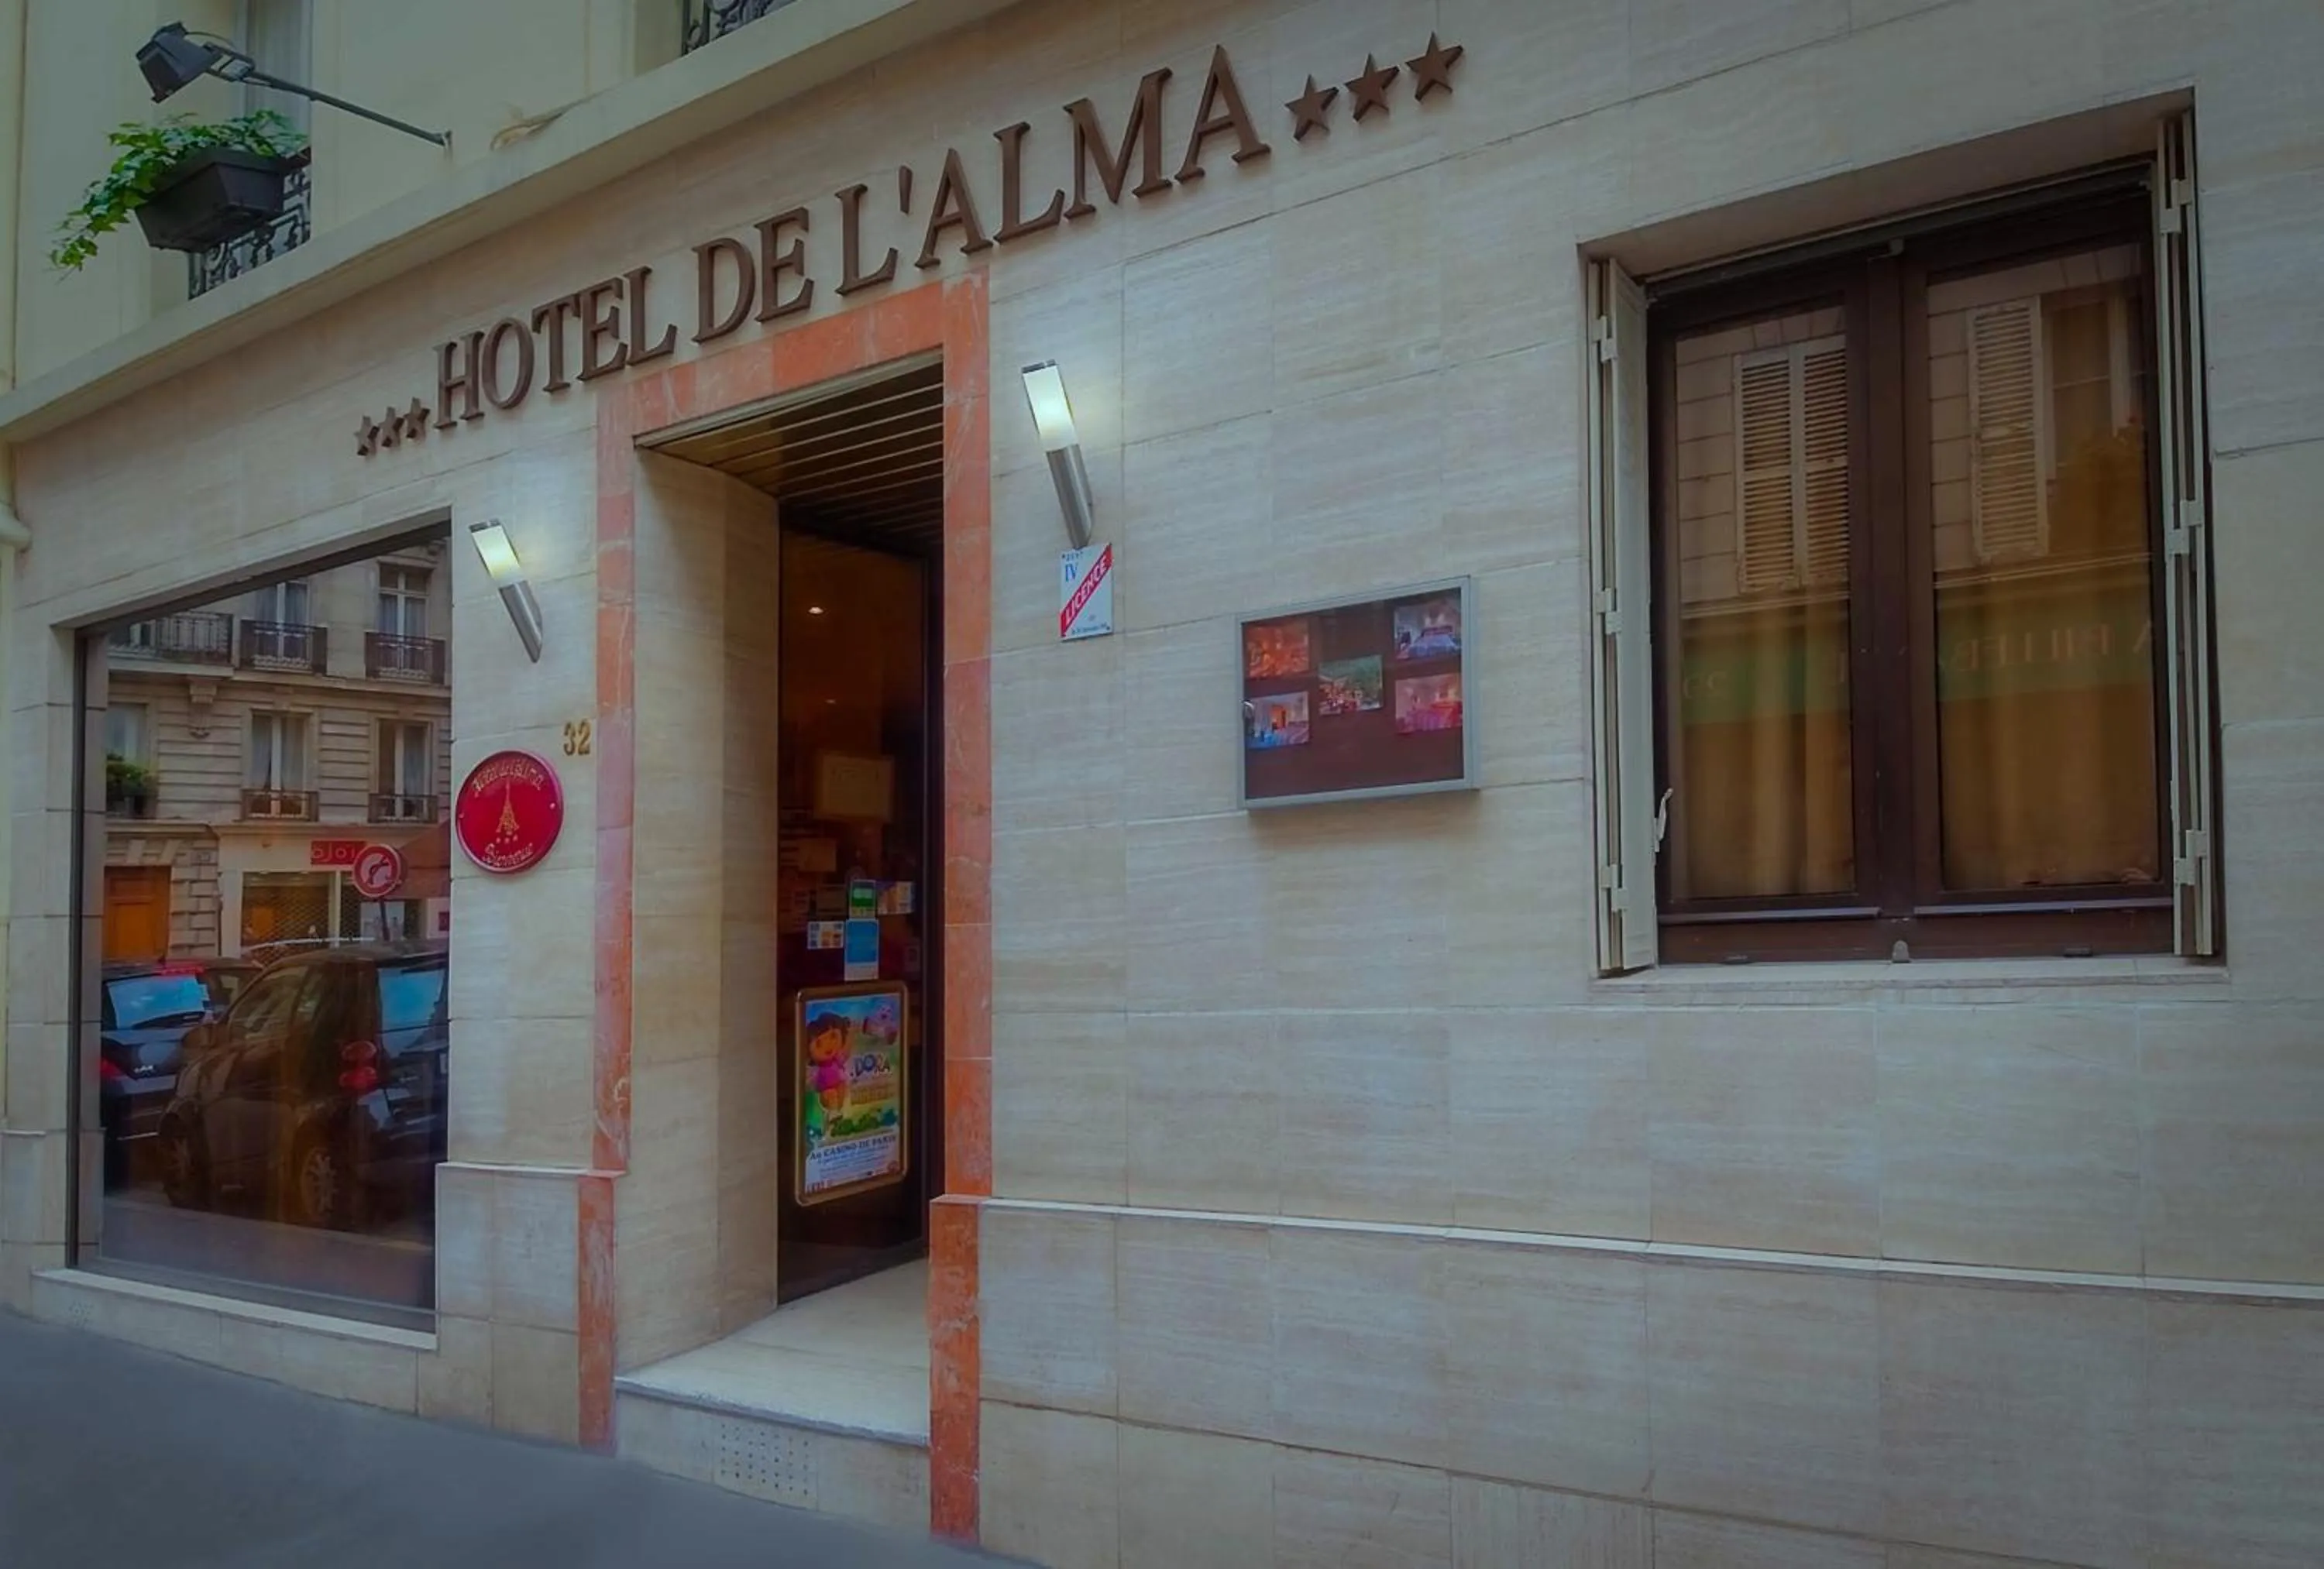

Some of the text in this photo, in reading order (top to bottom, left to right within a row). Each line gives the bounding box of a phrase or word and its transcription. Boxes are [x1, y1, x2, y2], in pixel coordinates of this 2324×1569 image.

[433, 43, 1271, 430] HOTEL DE L'ALMA
[1065, 554, 1109, 626] LICENCE
[563, 719, 591, 756] 32
